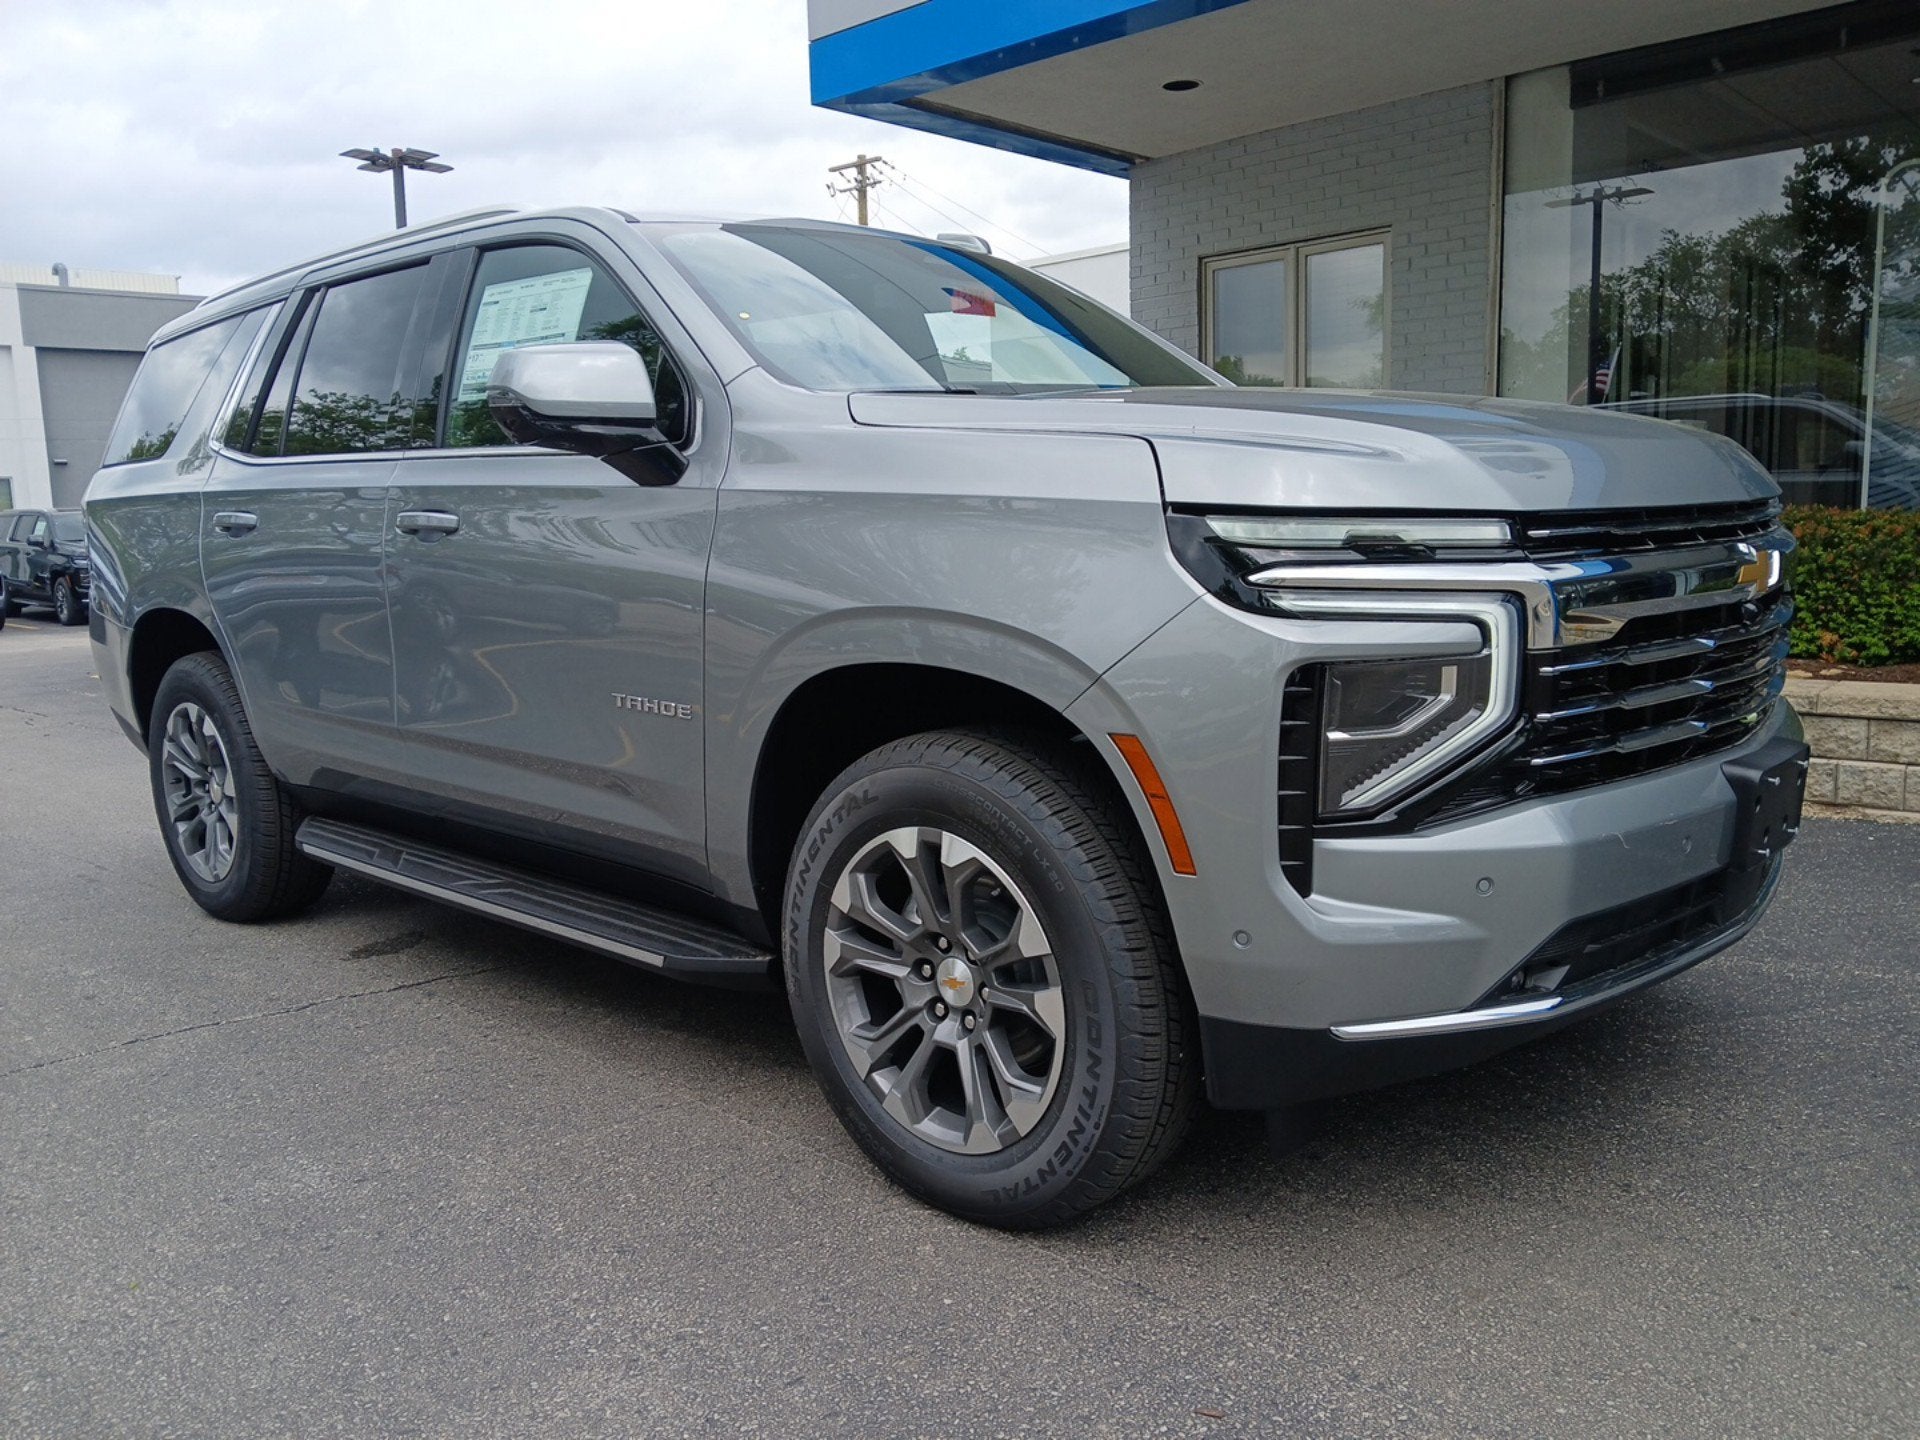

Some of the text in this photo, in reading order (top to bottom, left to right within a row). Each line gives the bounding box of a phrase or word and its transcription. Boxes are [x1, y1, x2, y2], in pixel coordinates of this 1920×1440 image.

[611, 692, 692, 720] TAHOE
[788, 788, 880, 1000] CONTINENTAL
[980, 978, 1103, 1205] CONTINENTAL
